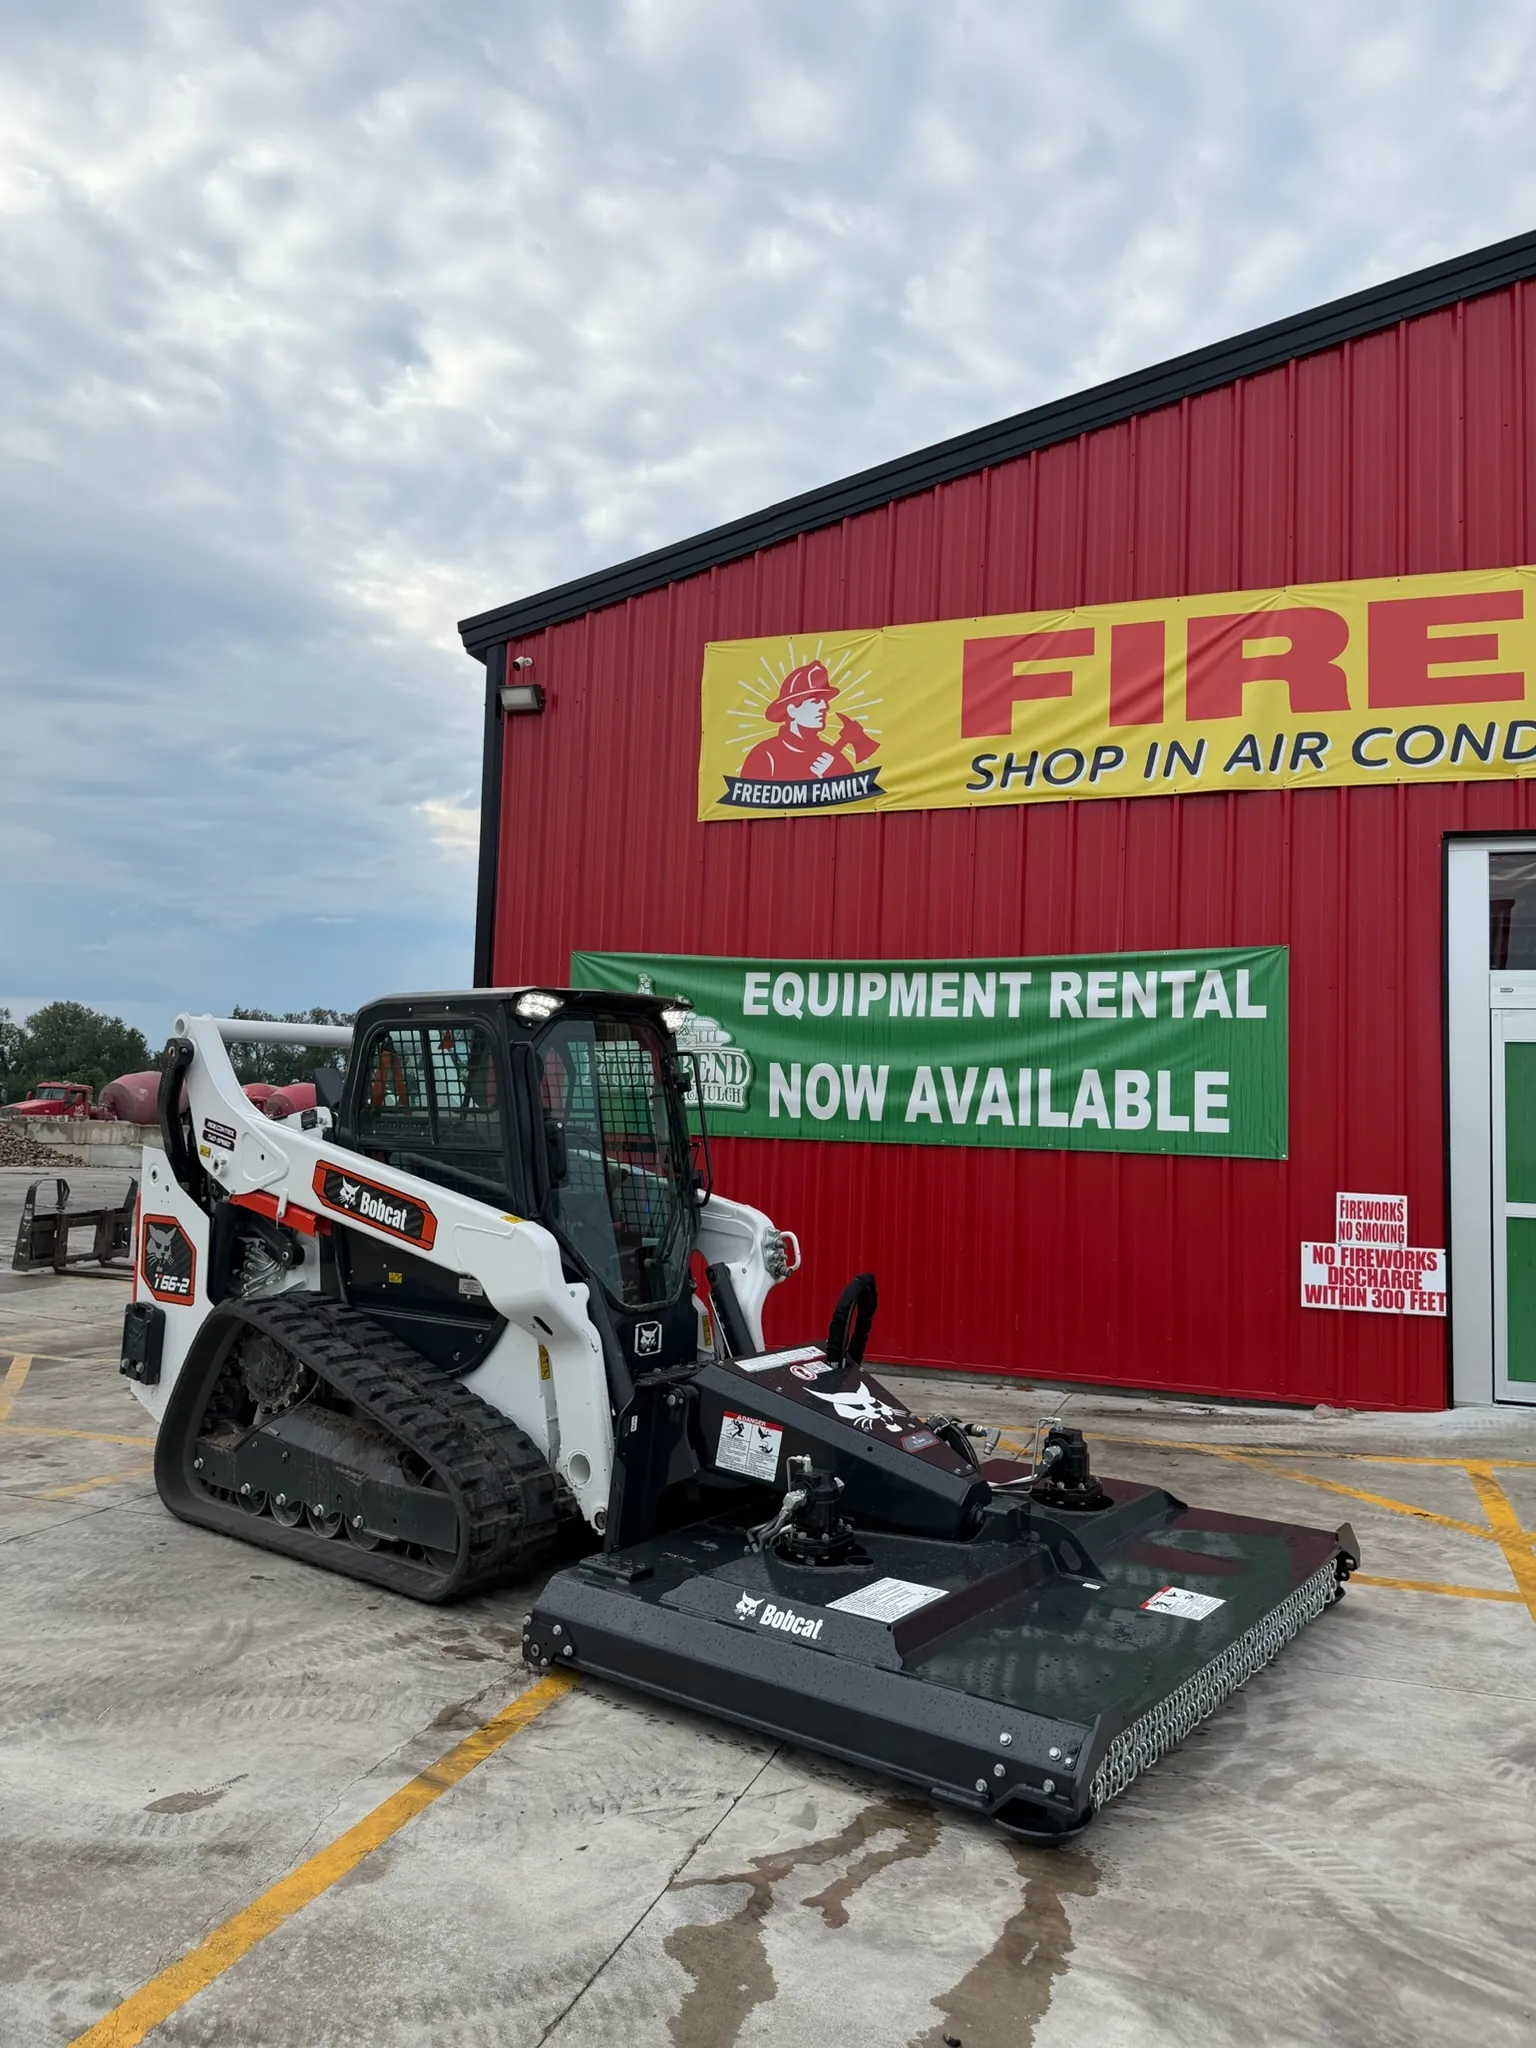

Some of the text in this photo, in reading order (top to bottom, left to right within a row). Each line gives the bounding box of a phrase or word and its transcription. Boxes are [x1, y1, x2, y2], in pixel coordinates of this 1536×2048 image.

[961, 589, 1526, 739] FIRE
[966, 745, 1127, 793] SHOP
[1143, 737, 1206, 782] IN
[1224, 730, 1332, 775] AIR
[731, 774, 871, 805] FREEDOM FAMILY
[742, 968, 1268, 1020] EQUIPMENT RENTAL
[768, 1062, 1231, 1134] NOW AVAILABLE
[359, 1191, 407, 1232] Bobcat
[1339, 1199, 1404, 1223] FIREWORKS
[1338, 1221, 1405, 1244] NO SMOKING
[1312, 1245, 1438, 1272] NO FIREWORKS
[154, 1273, 191, 1294] T66-2
[1327, 1266, 1423, 1291] DISCHARGE
[1305, 1284, 1447, 1312] WITHIN 300 FEET
[742, 1415, 767, 1427] DANGER
[758, 1603, 824, 1641] Bobcat
